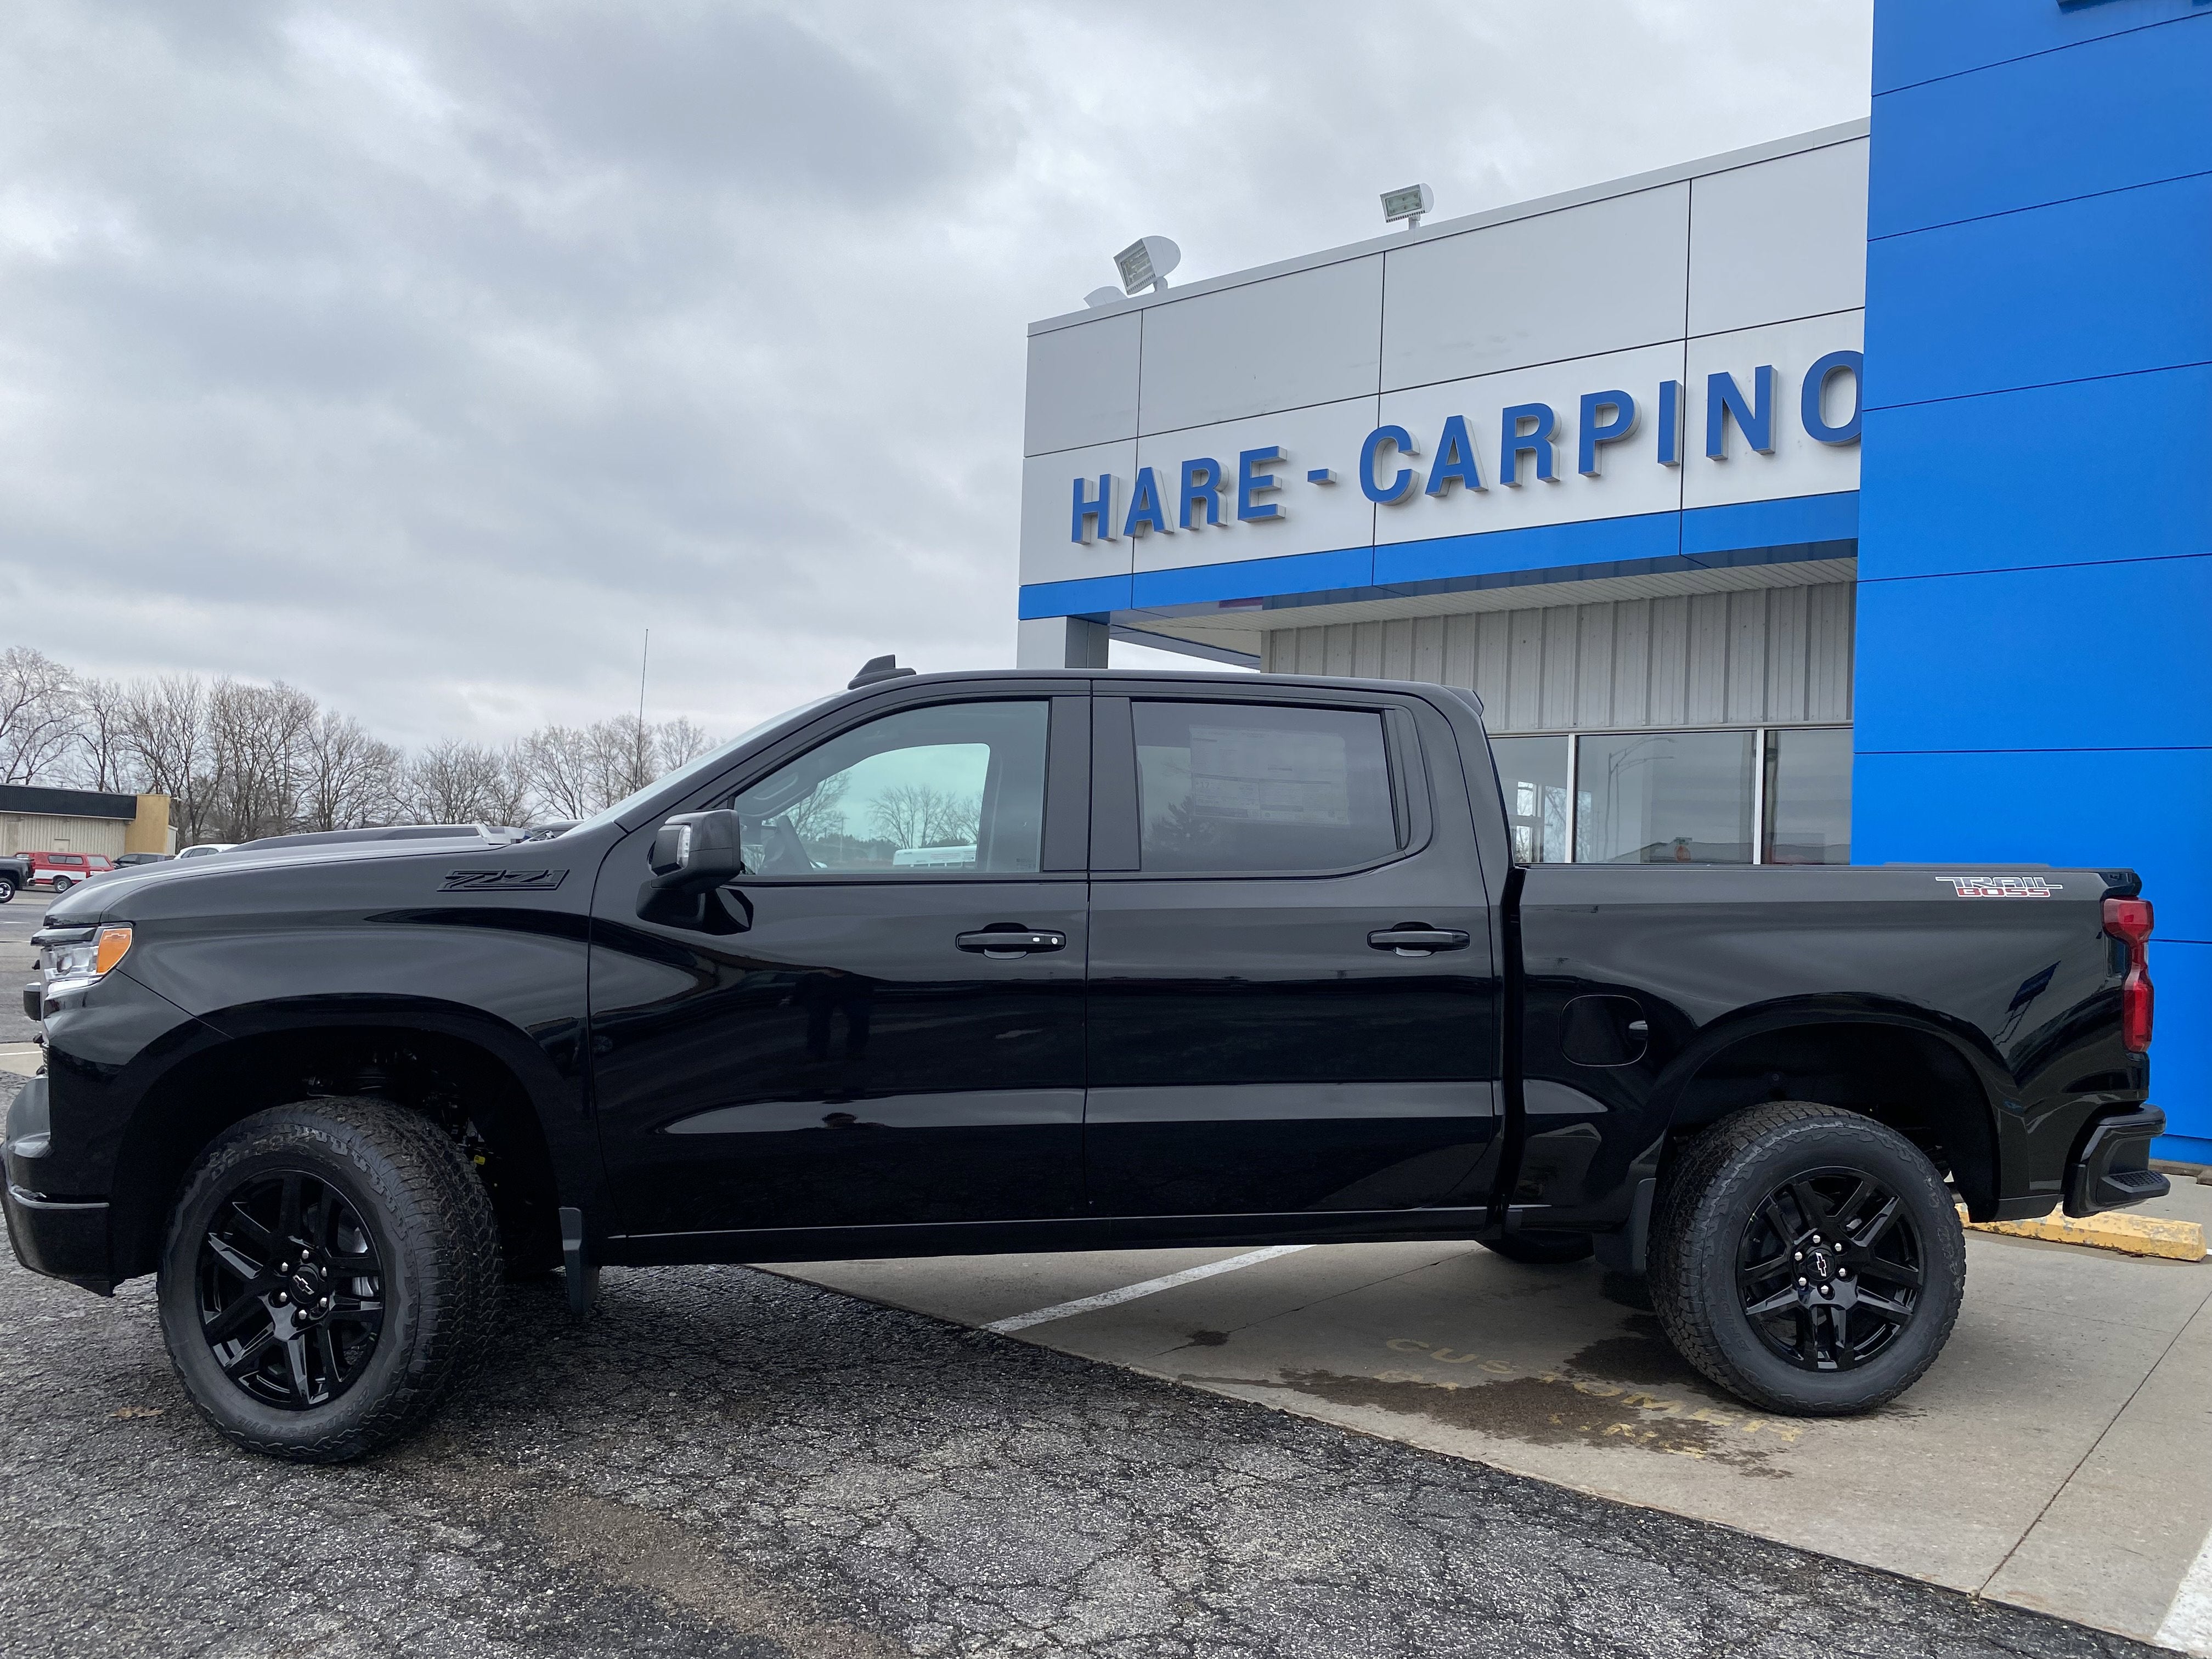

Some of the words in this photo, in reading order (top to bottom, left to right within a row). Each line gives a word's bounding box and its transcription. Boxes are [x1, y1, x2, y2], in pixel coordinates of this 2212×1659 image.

[1071, 445, 1288, 545] HARE
[1358, 349, 1864, 507] CARPINO
[437, 869, 570, 893] Z71
[1935, 876, 2063, 889] TRAIL
[1955, 887, 2051, 898] BOSS
